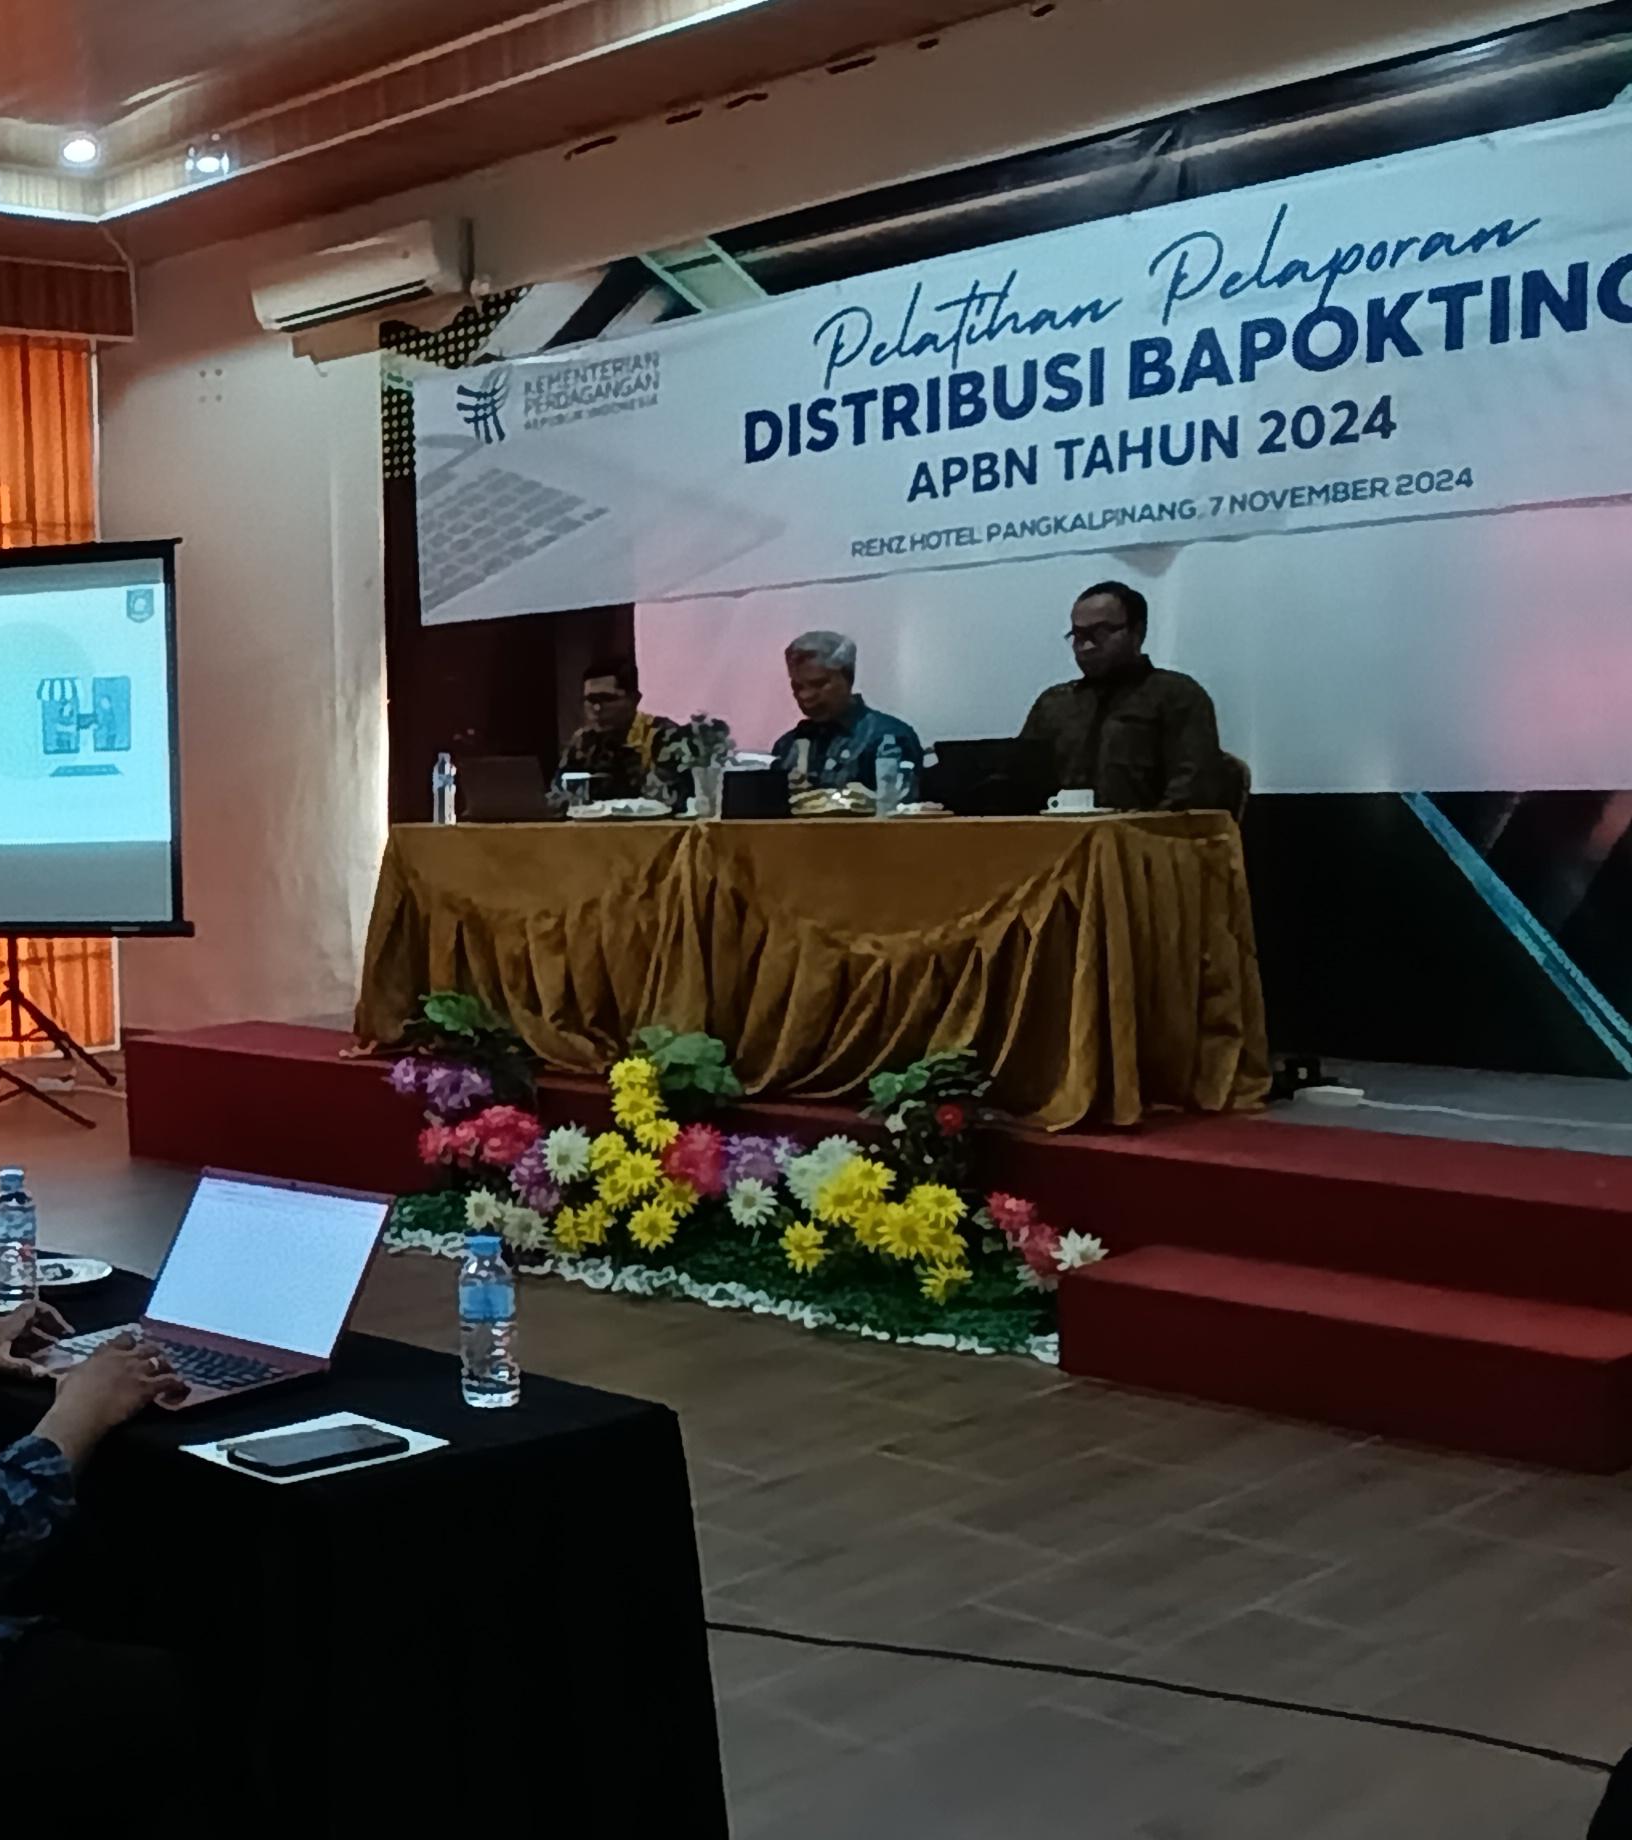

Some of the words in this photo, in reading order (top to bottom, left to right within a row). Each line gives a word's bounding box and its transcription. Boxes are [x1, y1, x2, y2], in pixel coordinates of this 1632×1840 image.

[813, 269, 1123, 390] Pelatihan
[1148, 203, 1541, 325] Pelaporan
[744, 347, 1105, 464] DISTRIBUSI
[906, 445, 1038, 502] APBN
[1054, 415, 1239, 481] TAHUN
[1257, 395, 1398, 456] 2024
[851, 535, 908, 558] RENZ
[909, 526, 983, 552] HOTEL
[1209, 496, 1224, 517] 7
[1228, 477, 1390, 514] NOVEMBER
[1394, 467, 1475, 497] 2024
